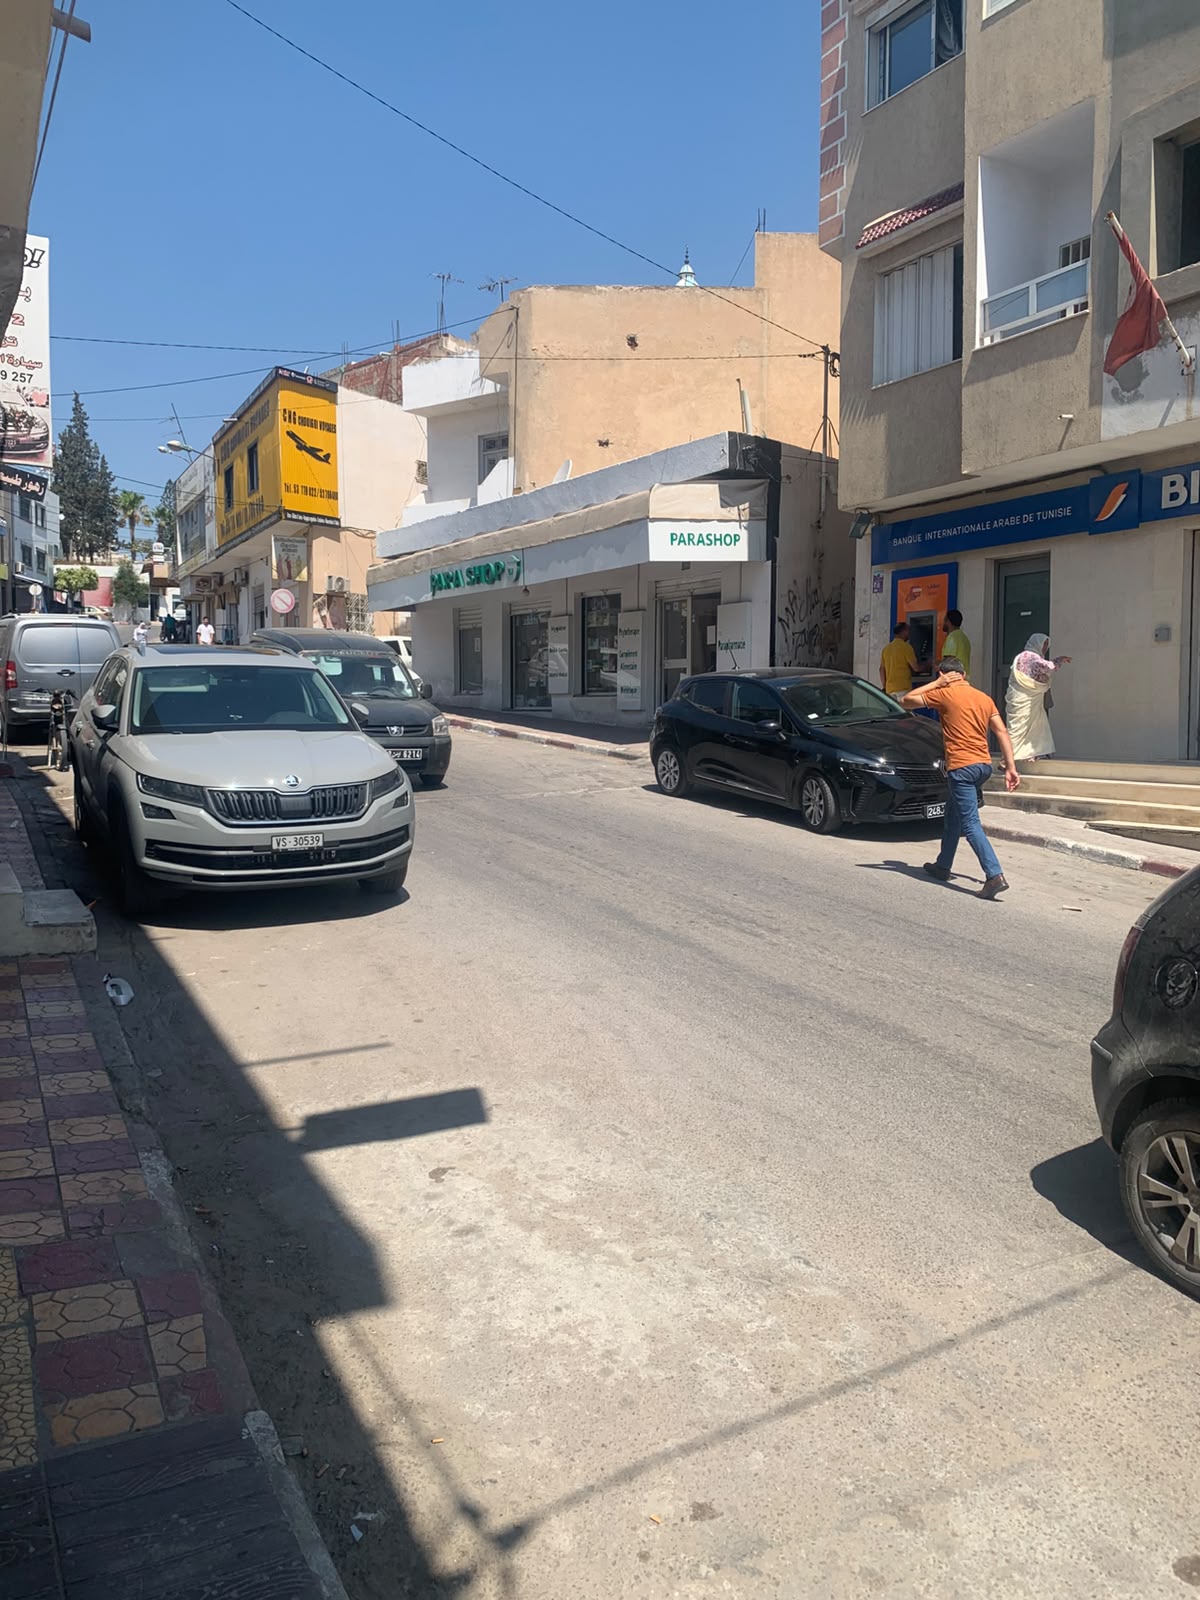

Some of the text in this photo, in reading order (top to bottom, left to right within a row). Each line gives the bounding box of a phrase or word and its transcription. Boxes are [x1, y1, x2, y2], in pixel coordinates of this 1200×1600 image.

[11, 371, 34, 384] 257
[669, 532, 741, 547] PARASHOP
[892, 506, 1073, 547] BANQUE INTERNATIONALE ARABE DE TUNISIE
[430, 560, 506, 597] PARA SHOP
